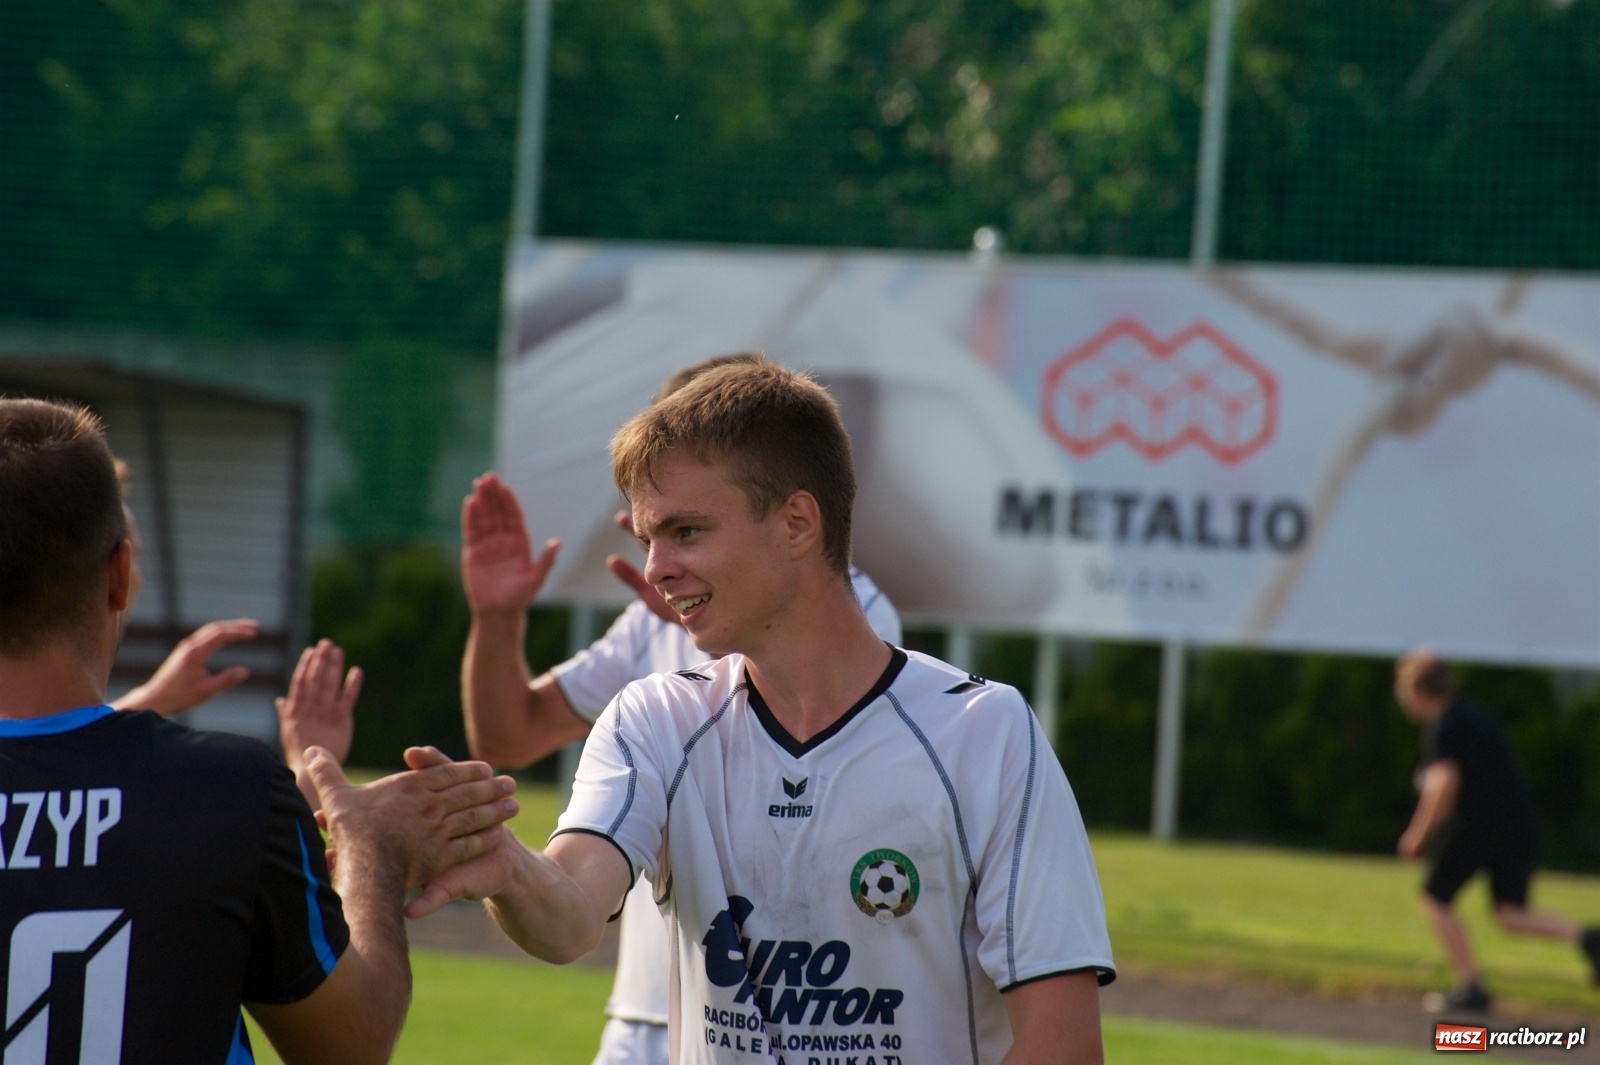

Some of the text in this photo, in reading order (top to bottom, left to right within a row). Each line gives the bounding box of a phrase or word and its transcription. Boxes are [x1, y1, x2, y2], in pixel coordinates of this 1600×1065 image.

[997, 486, 1309, 555] METALIO
[0, 787, 122, 869] ZYP
[768, 802, 813, 818] erima
[880, 1034, 902, 1050] 40
